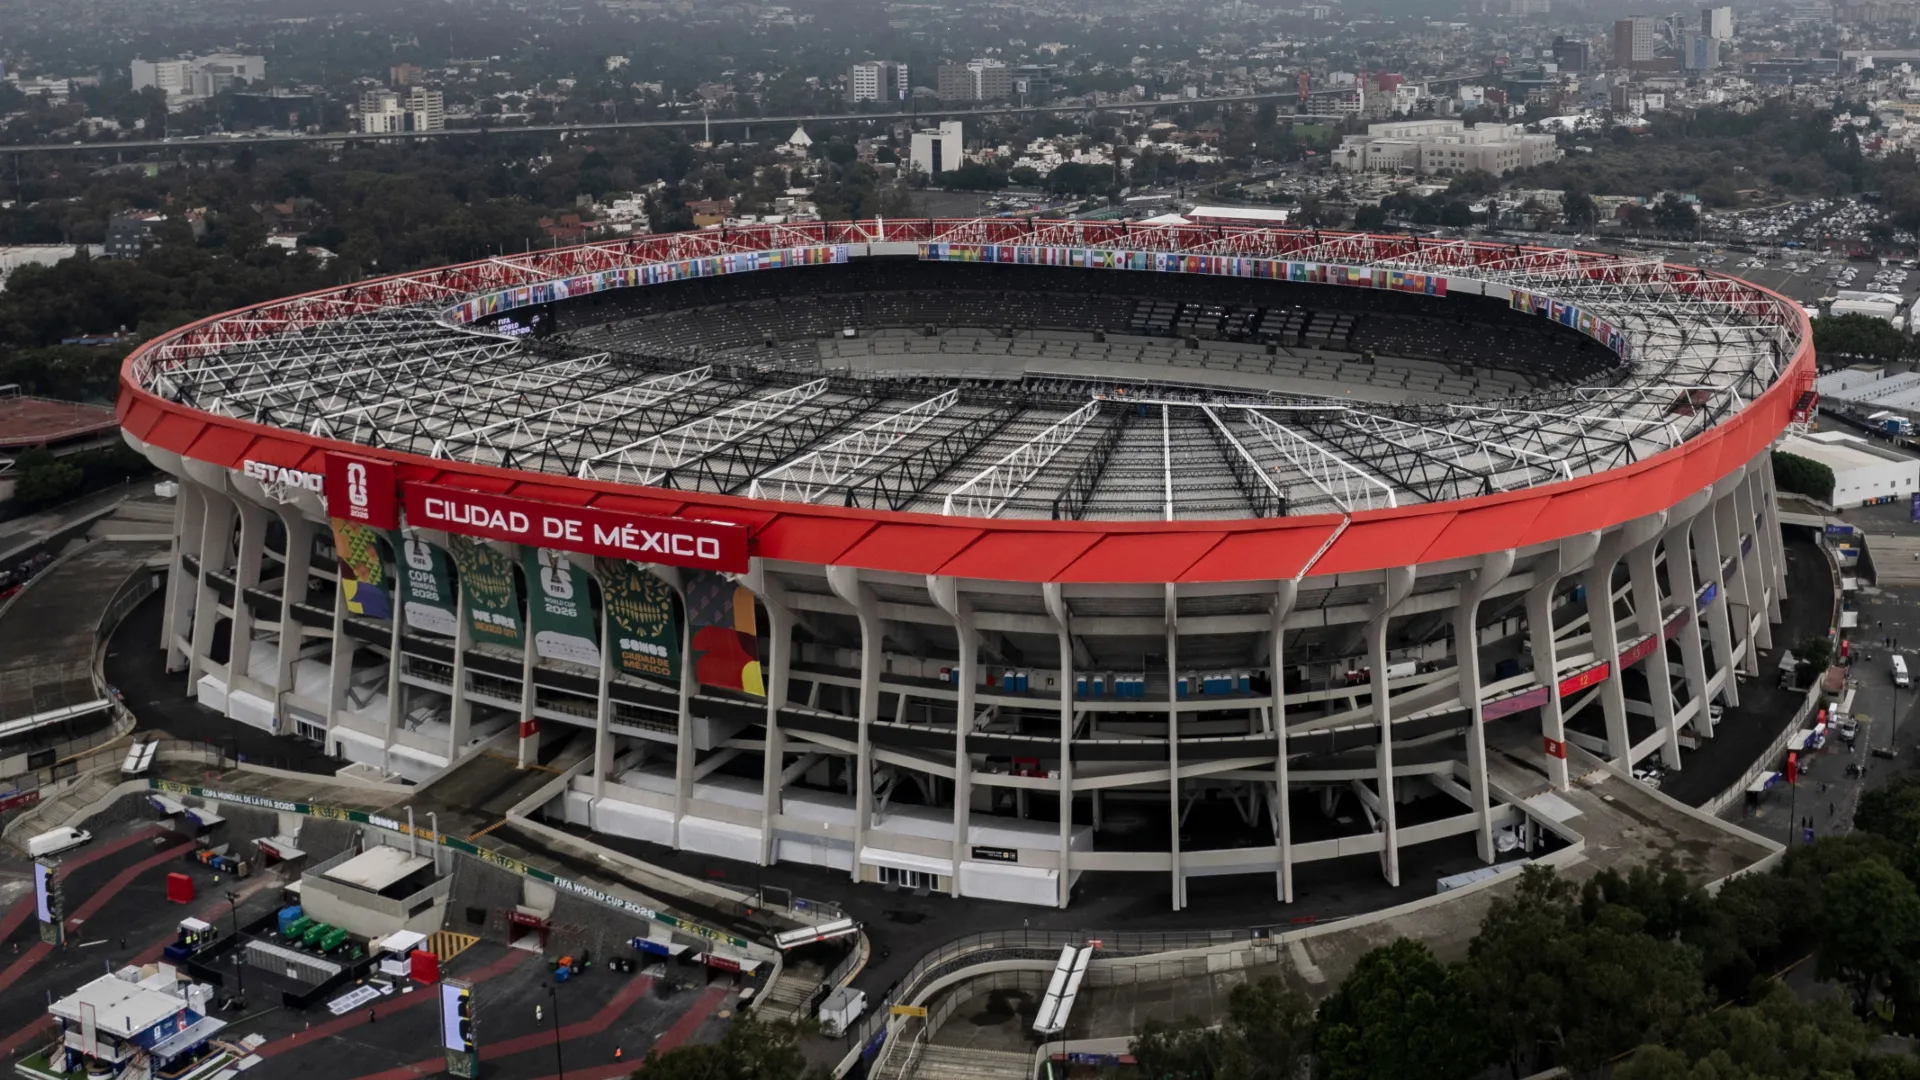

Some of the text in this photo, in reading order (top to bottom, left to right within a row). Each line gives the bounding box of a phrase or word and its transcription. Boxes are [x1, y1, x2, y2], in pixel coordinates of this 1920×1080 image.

[498, 322, 520, 333] WORLD
[243, 459, 323, 492] ESTADIO
[425, 497, 720, 560] CIUDAD DE MÉXICO
[413, 557, 427, 565] FIFA
[408, 569, 436, 585] COPA
[410, 580, 438, 592] MUNDIAL
[550, 584, 565, 593] FIFA
[411, 587, 440, 602] 2026
[545, 602, 578, 617] 2026
[619, 638, 668, 658] SOMOS
[621, 651, 670, 668] CIUDAD DE
[1580, 674, 1589, 687] 12
[1549, 742, 1556, 753] 2
[202, 788, 296, 811] COPA MUNDIAL DE LA FIFA 2026
[553, 876, 656, 919] FIFA WORLD CUP 2026
